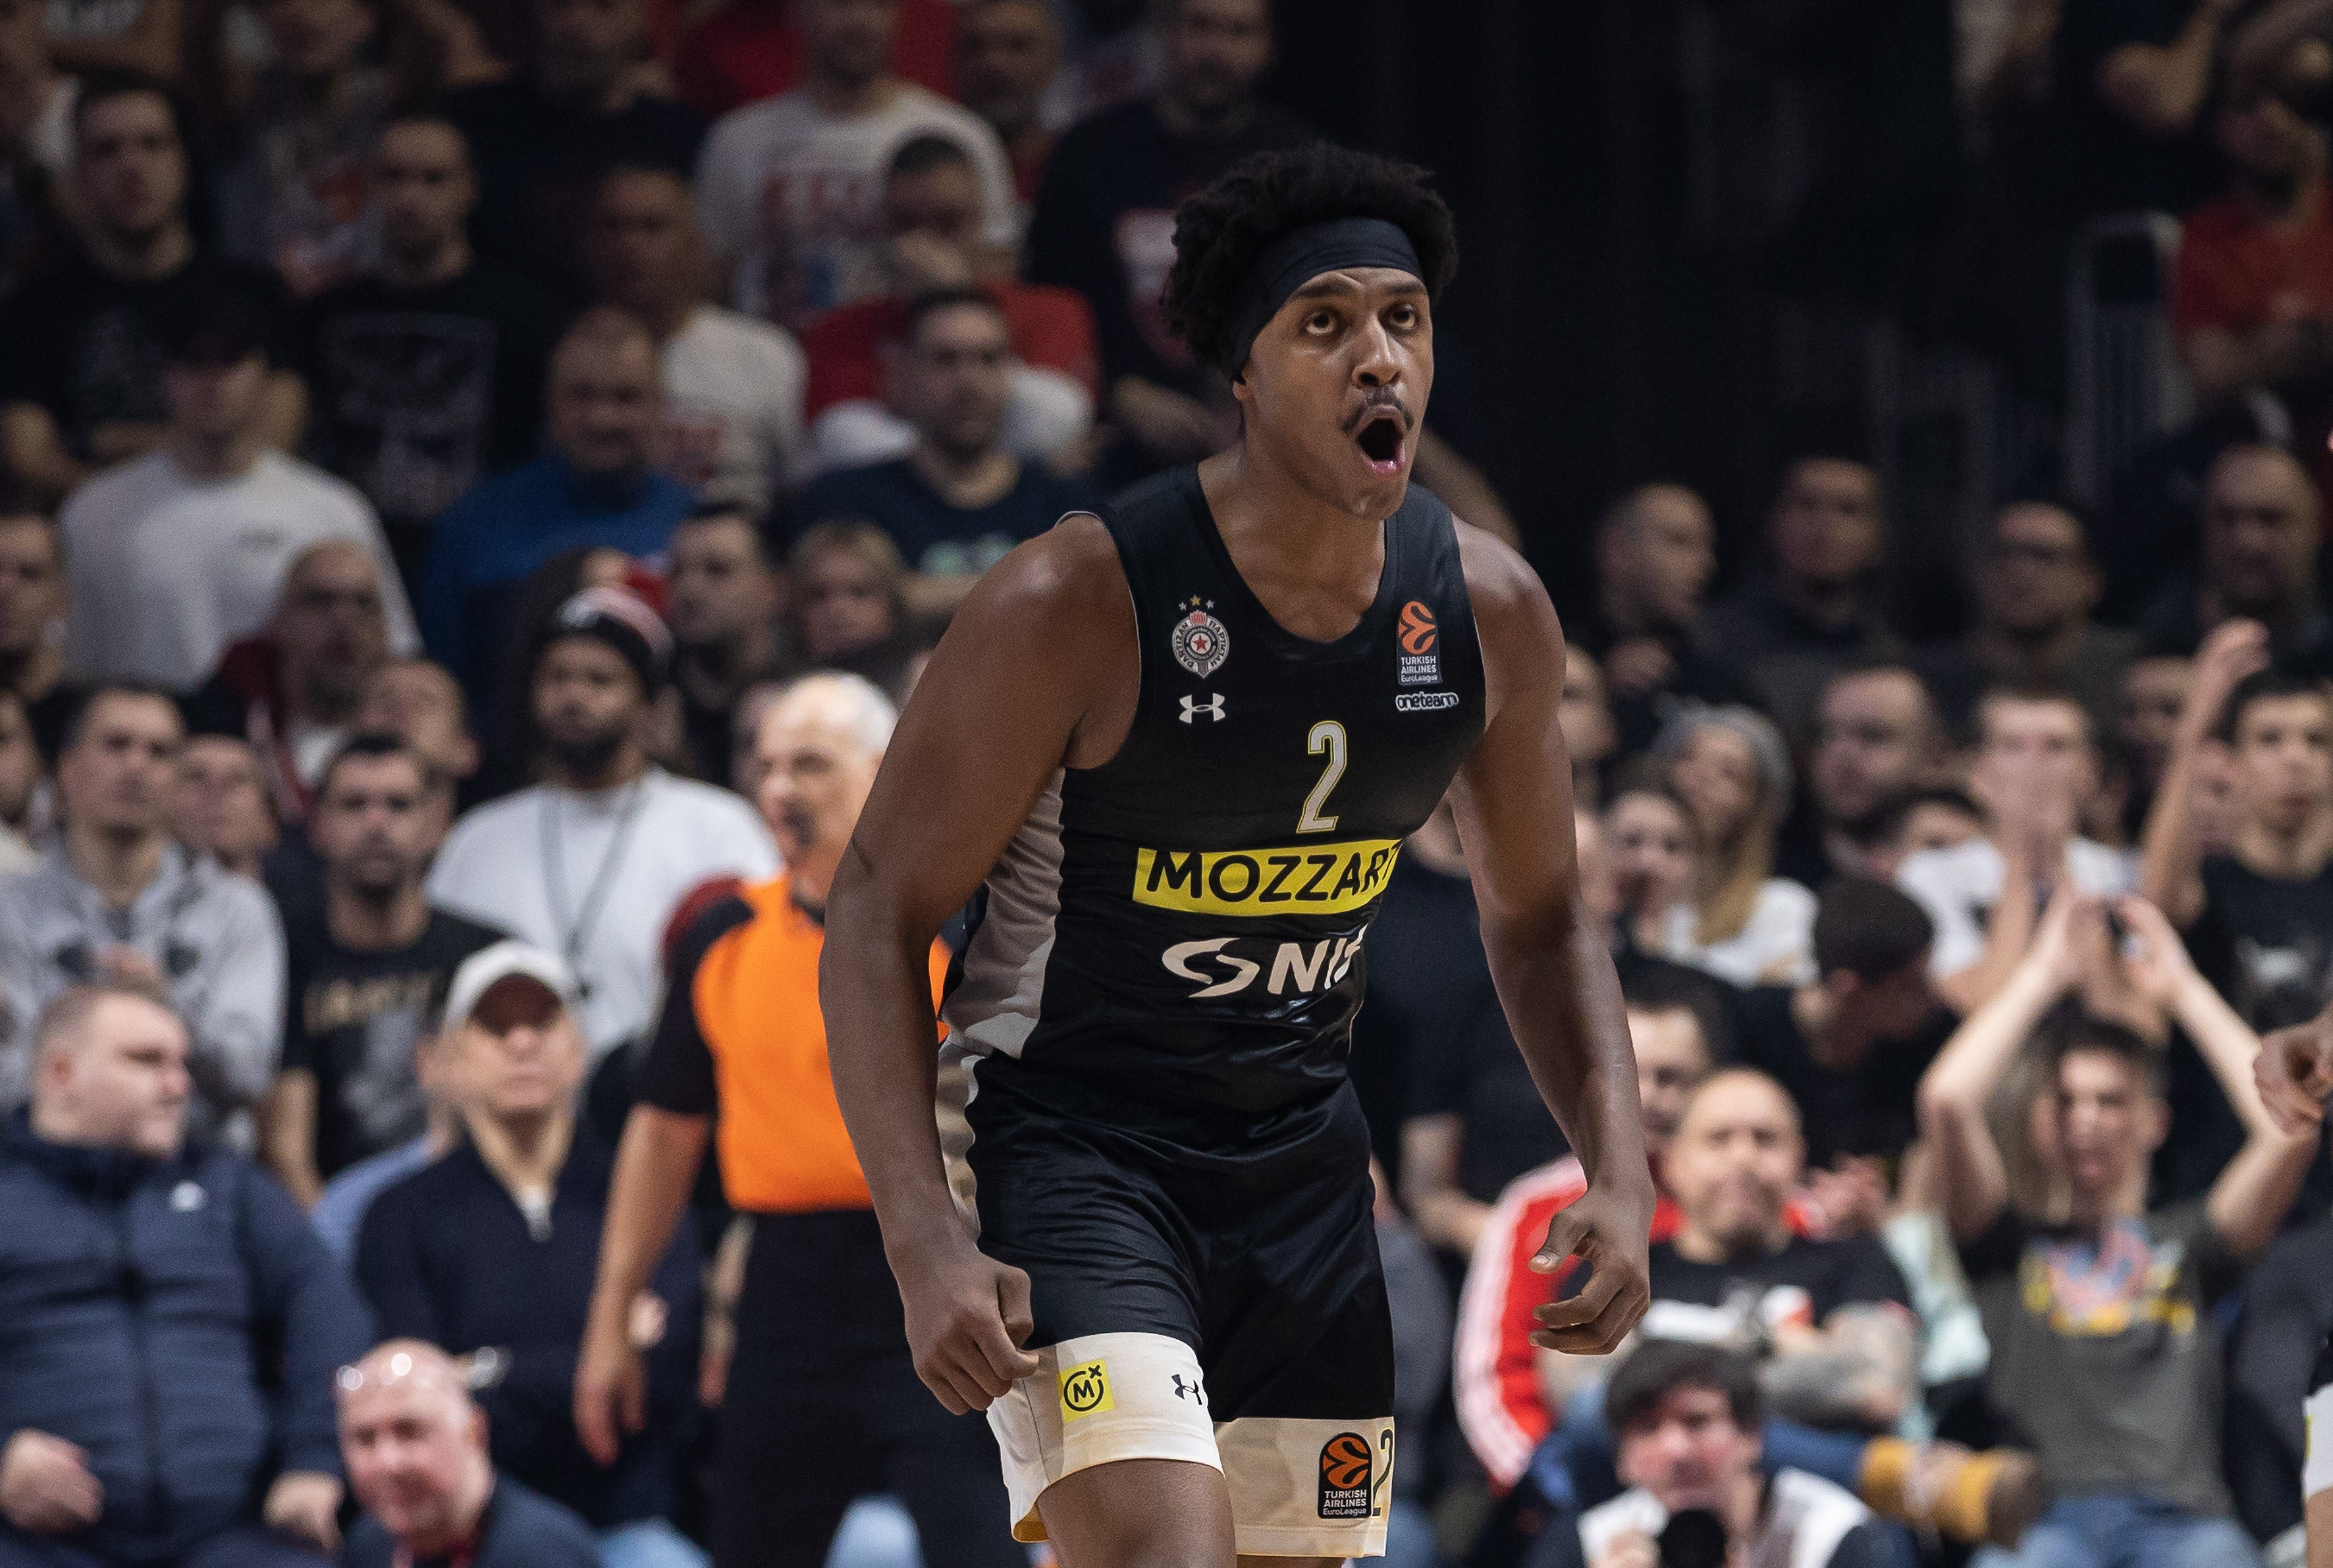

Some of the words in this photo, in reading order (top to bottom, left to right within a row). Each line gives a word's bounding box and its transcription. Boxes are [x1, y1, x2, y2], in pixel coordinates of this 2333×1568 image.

[1401, 655, 1436, 666] TURKISH
[1401, 664, 1437, 675] AIRLINES
[1401, 674, 1438, 683] EuroLeague
[1397, 693, 1459, 710] oneteam
[1297, 720, 1347, 834] 2
[1324, 1489, 1367, 1500] TURKISH
[1323, 1498, 1367, 1508] AIRLINES
[1323, 1507, 1367, 1516] EuroLeague
